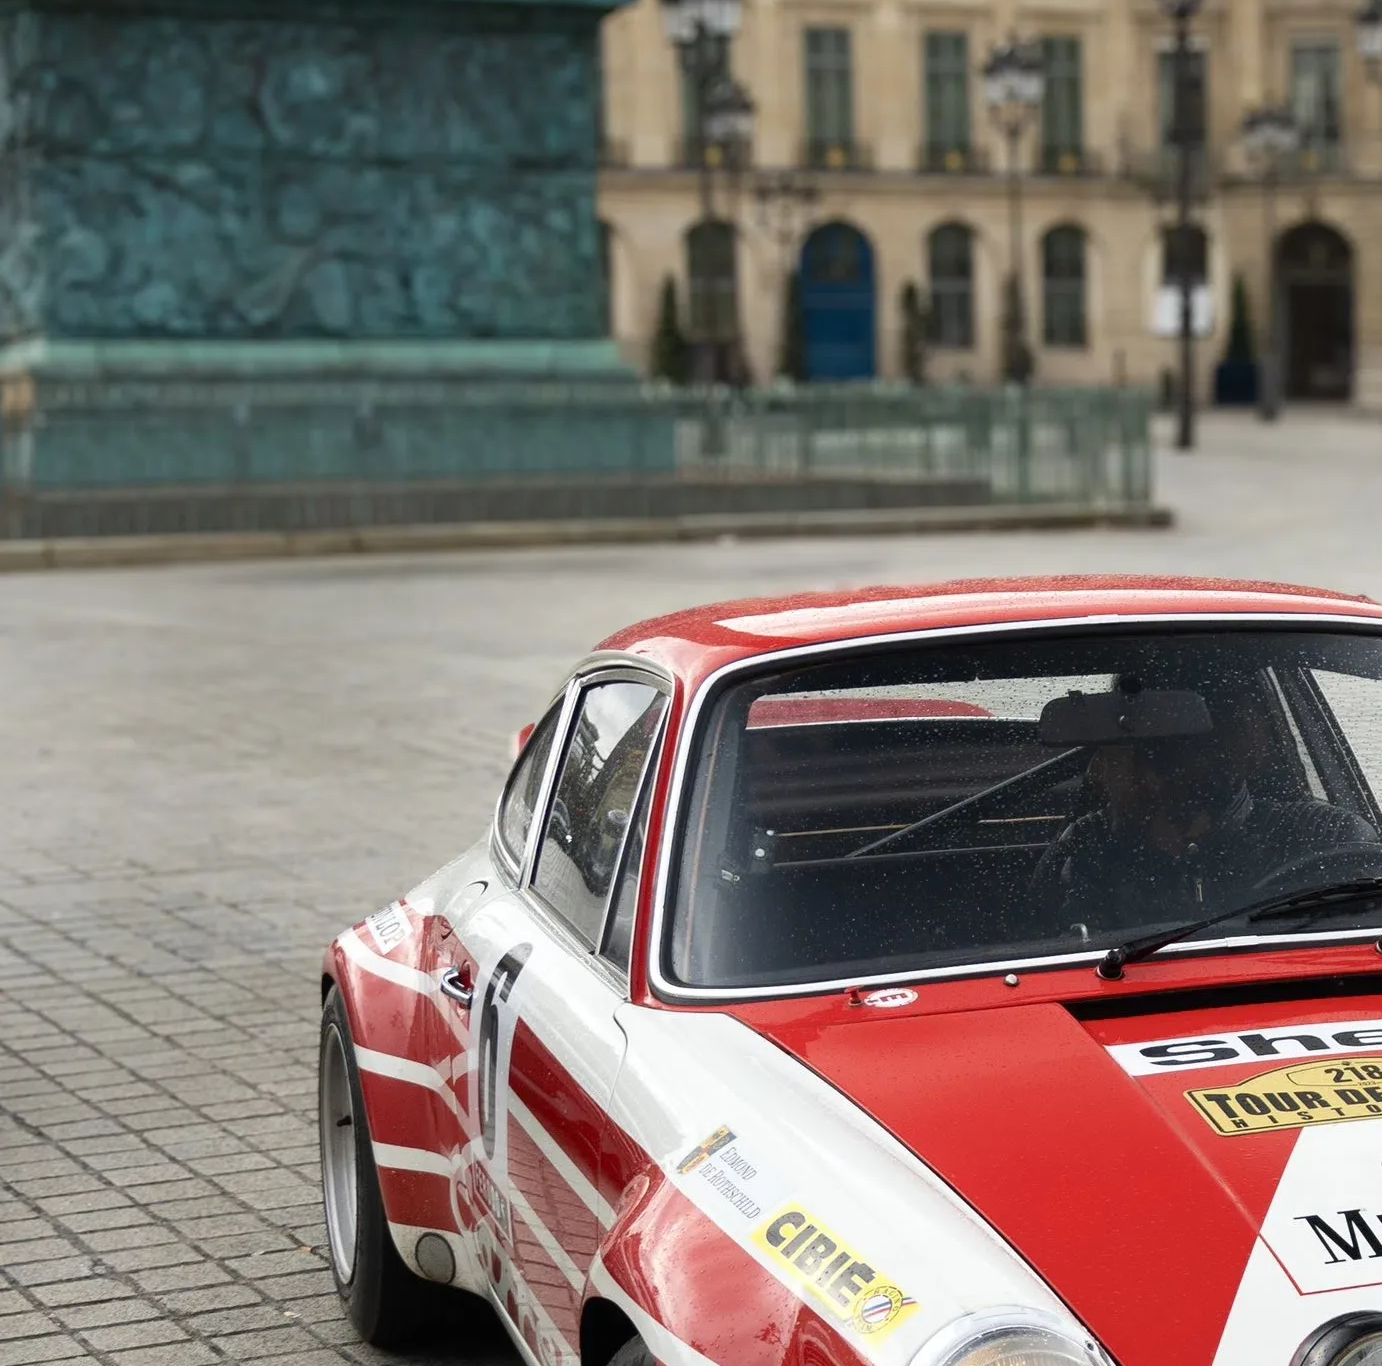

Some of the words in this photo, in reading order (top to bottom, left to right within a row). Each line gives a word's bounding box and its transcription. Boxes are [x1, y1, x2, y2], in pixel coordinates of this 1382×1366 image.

[479, 942, 533, 1161] 6
[1204, 1088, 1327, 1119] TOUR
[698, 1163, 717, 1179] DE
[719, 1146, 758, 1180] EDMOND
[707, 1170, 761, 1219] ROTHSCHILD
